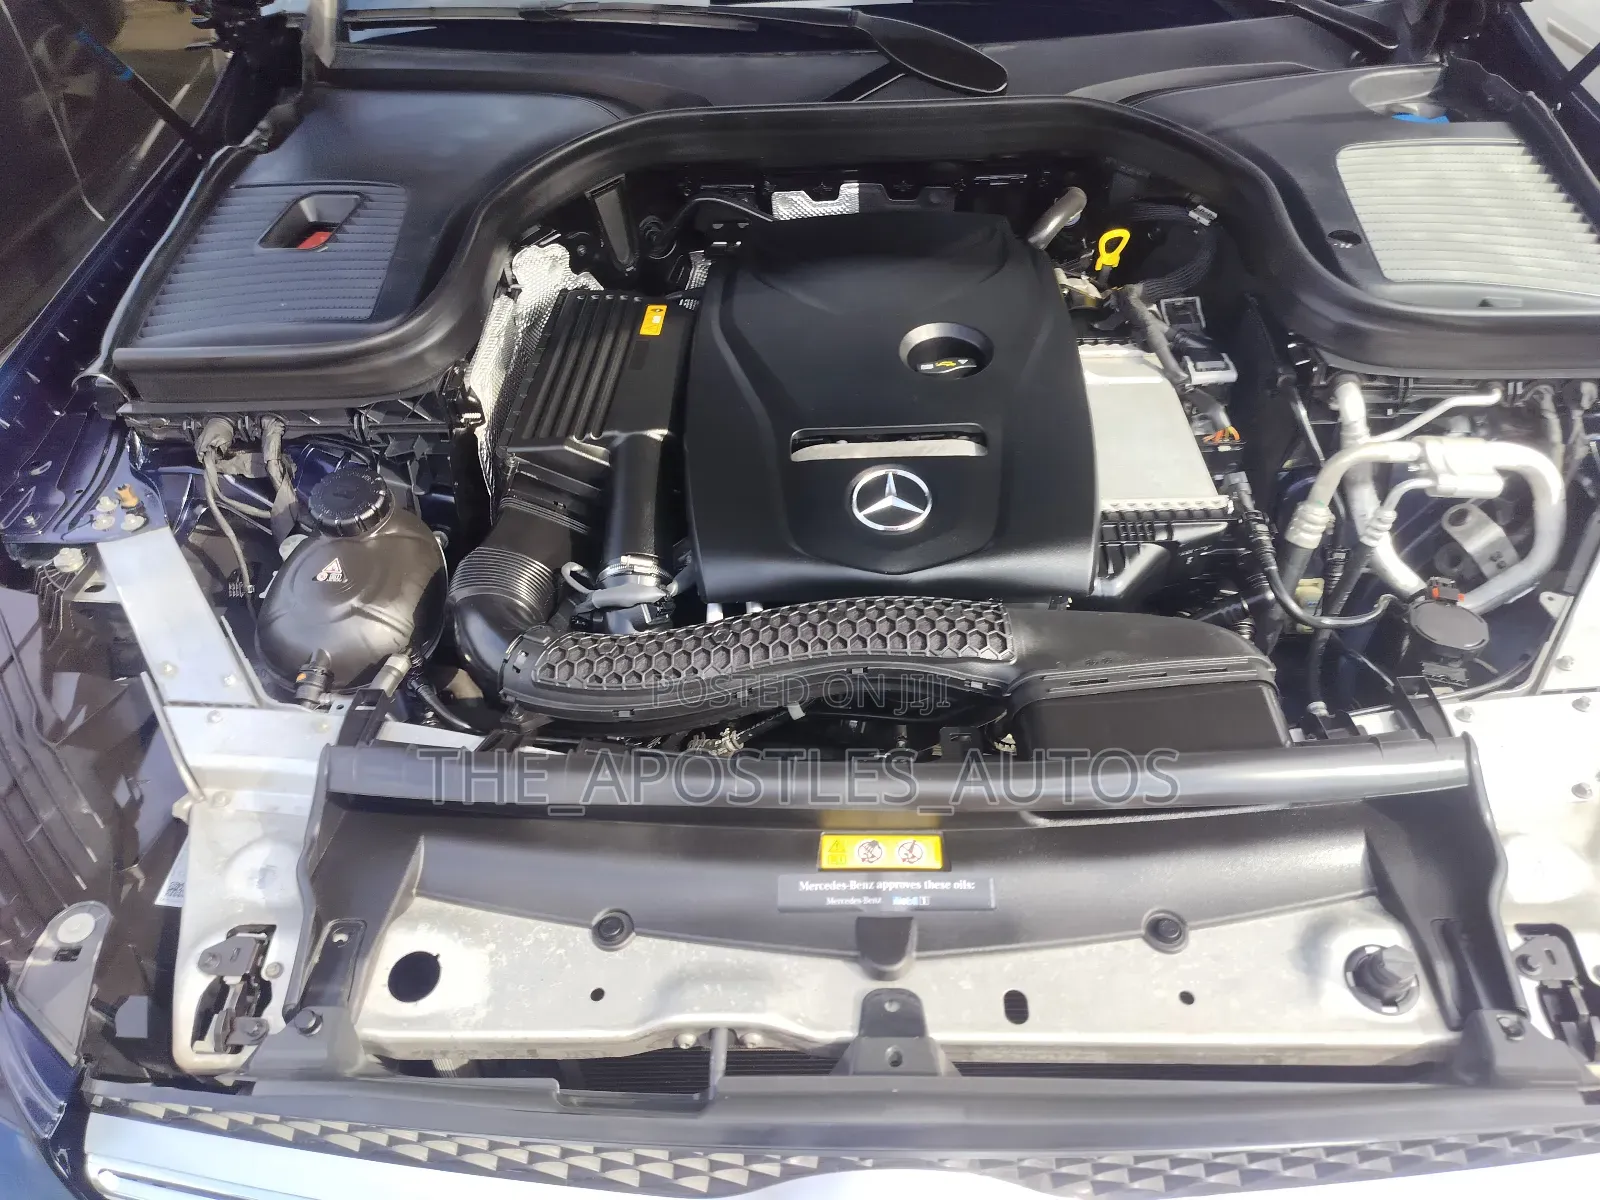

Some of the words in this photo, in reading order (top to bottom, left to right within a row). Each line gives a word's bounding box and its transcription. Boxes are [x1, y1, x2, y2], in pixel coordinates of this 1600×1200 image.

[798, 880, 875, 892] Mercedes-Benz
[876, 881, 922, 892] approves
[923, 880, 952, 890] these
